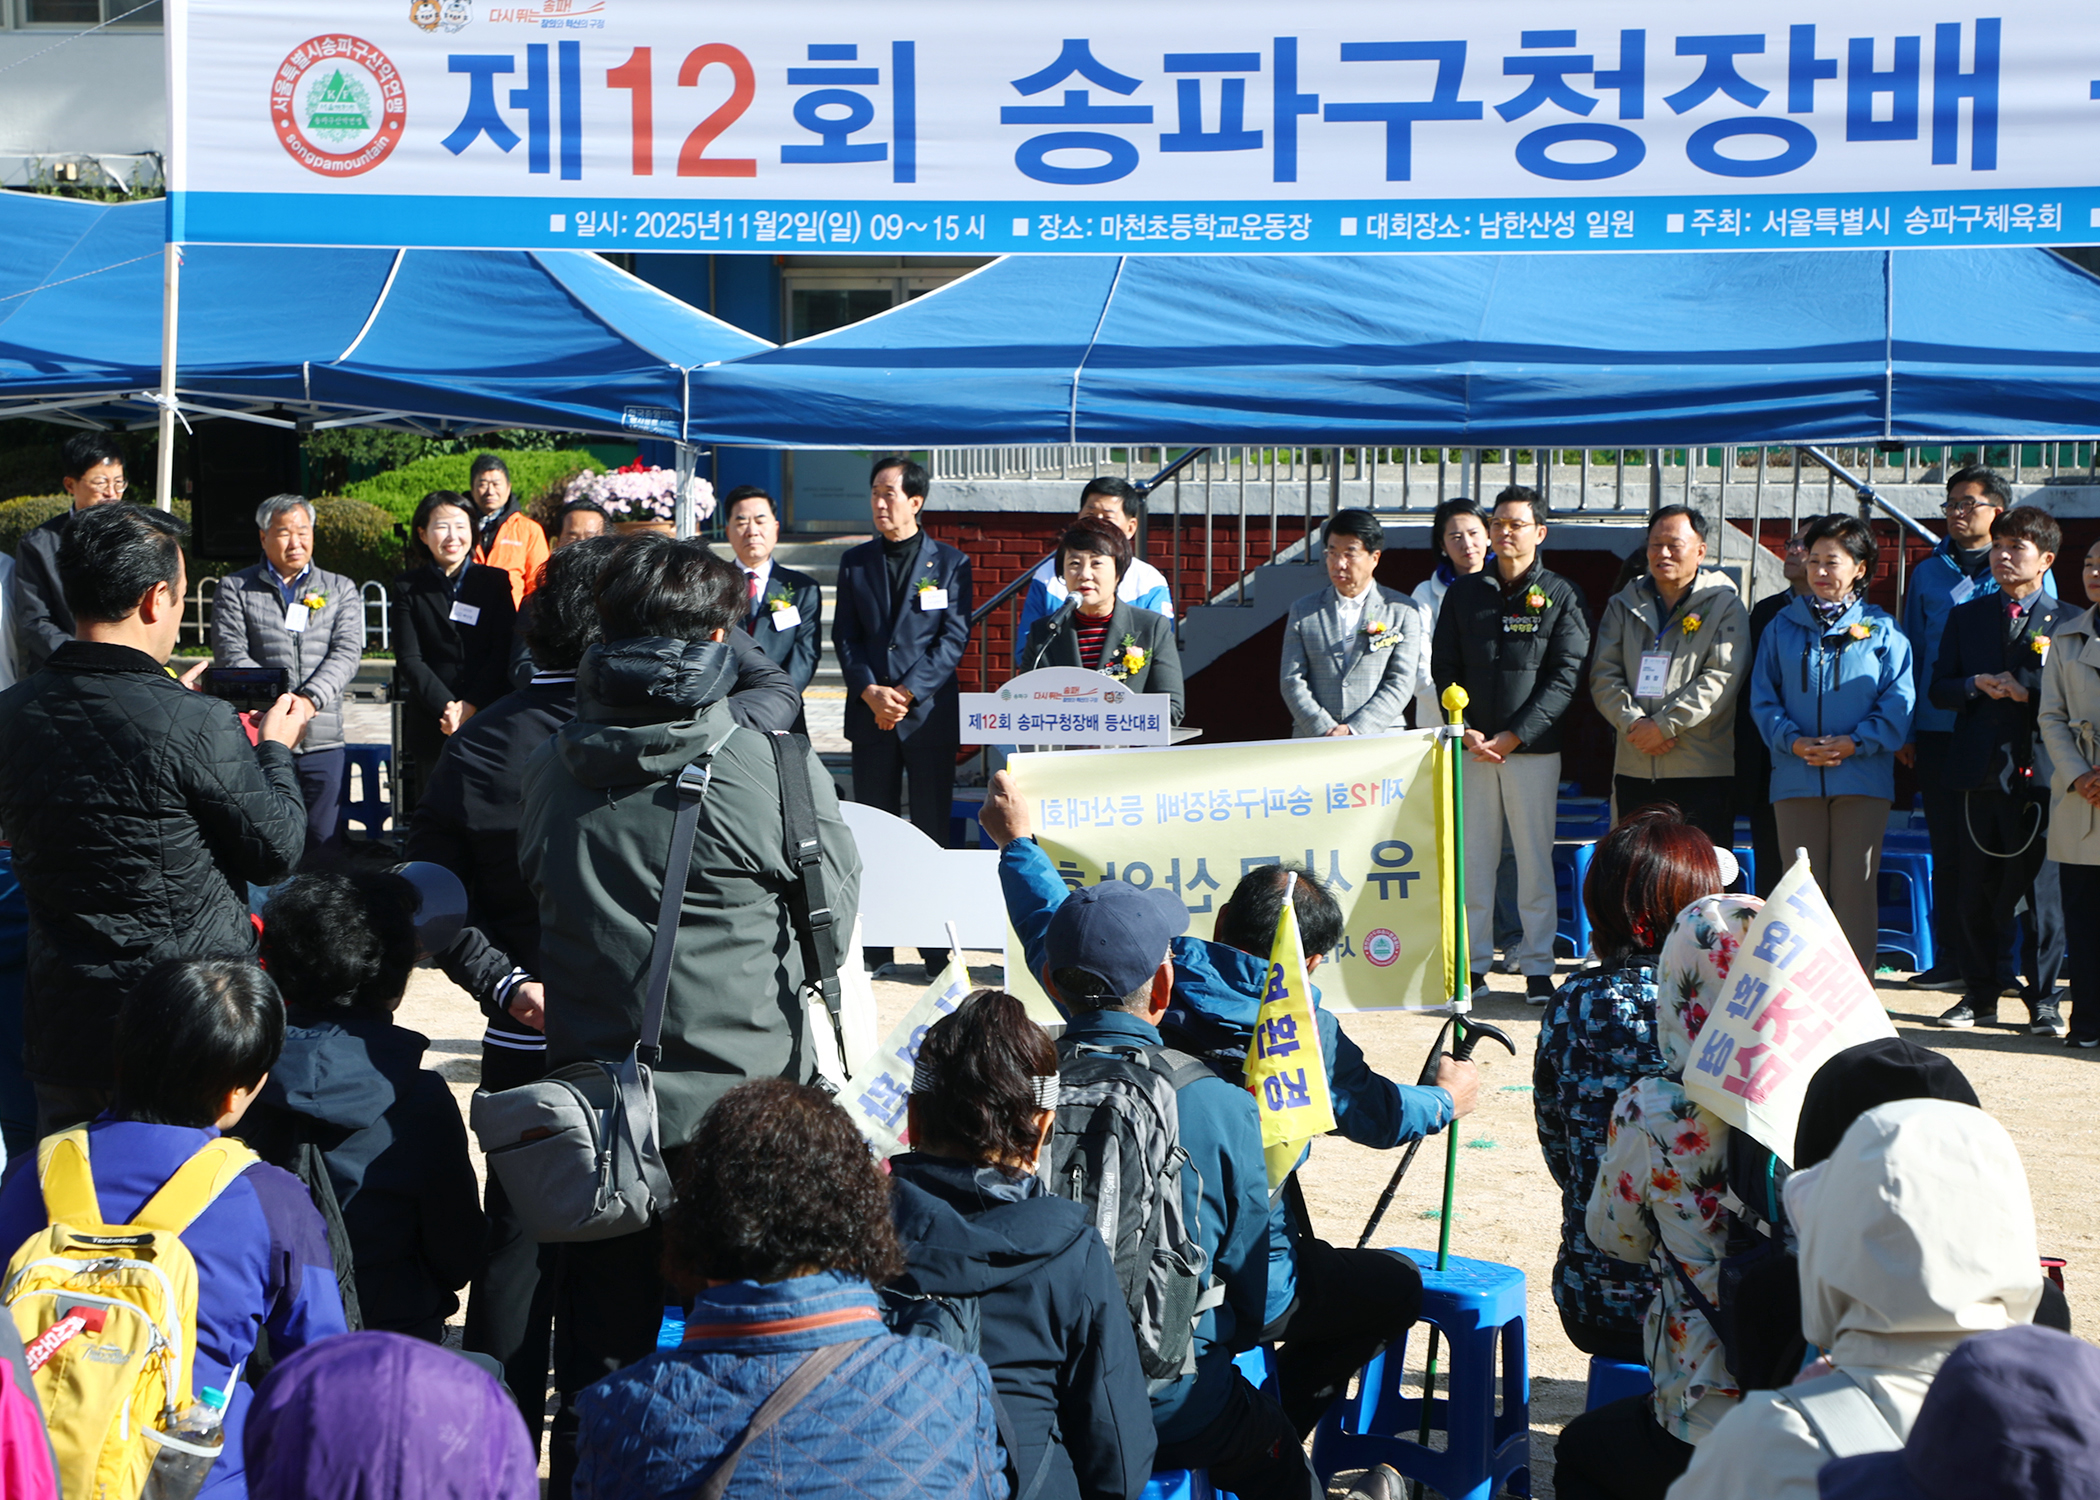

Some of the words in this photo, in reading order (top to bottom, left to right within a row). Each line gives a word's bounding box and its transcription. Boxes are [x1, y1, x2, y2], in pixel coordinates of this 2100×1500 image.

[489, 8, 514, 23] 다시
[516, 8, 540, 23] 뛰는
[440, 40, 917, 184] 제12회
[1000, 17, 2001, 185] 송파구청장배
[286, 133, 390, 171] songpamountain
[575, 211, 627, 237] 일시:
[635, 210, 861, 244] 2025년11월2일(일)
[1038, 213, 1093, 241] 장소:
[1101, 213, 1312, 241] 마천초등학교운동장
[1367, 212, 1470, 240] 대회장소:
[1479, 211, 1576, 239] 남한산성
[1587, 210, 1635, 238] 일원
[1691, 208, 1751, 237] 주최:
[1763, 207, 1890, 236] 서울특별시
[1905, 203, 2062, 235] 송파구체육회
[968, 713, 1011, 731] 제12회
[1017, 713, 1099, 732] 송파구청장배
[1105, 714, 1160, 732] 등산대회
[1103, 1194, 1113, 1211] Your
